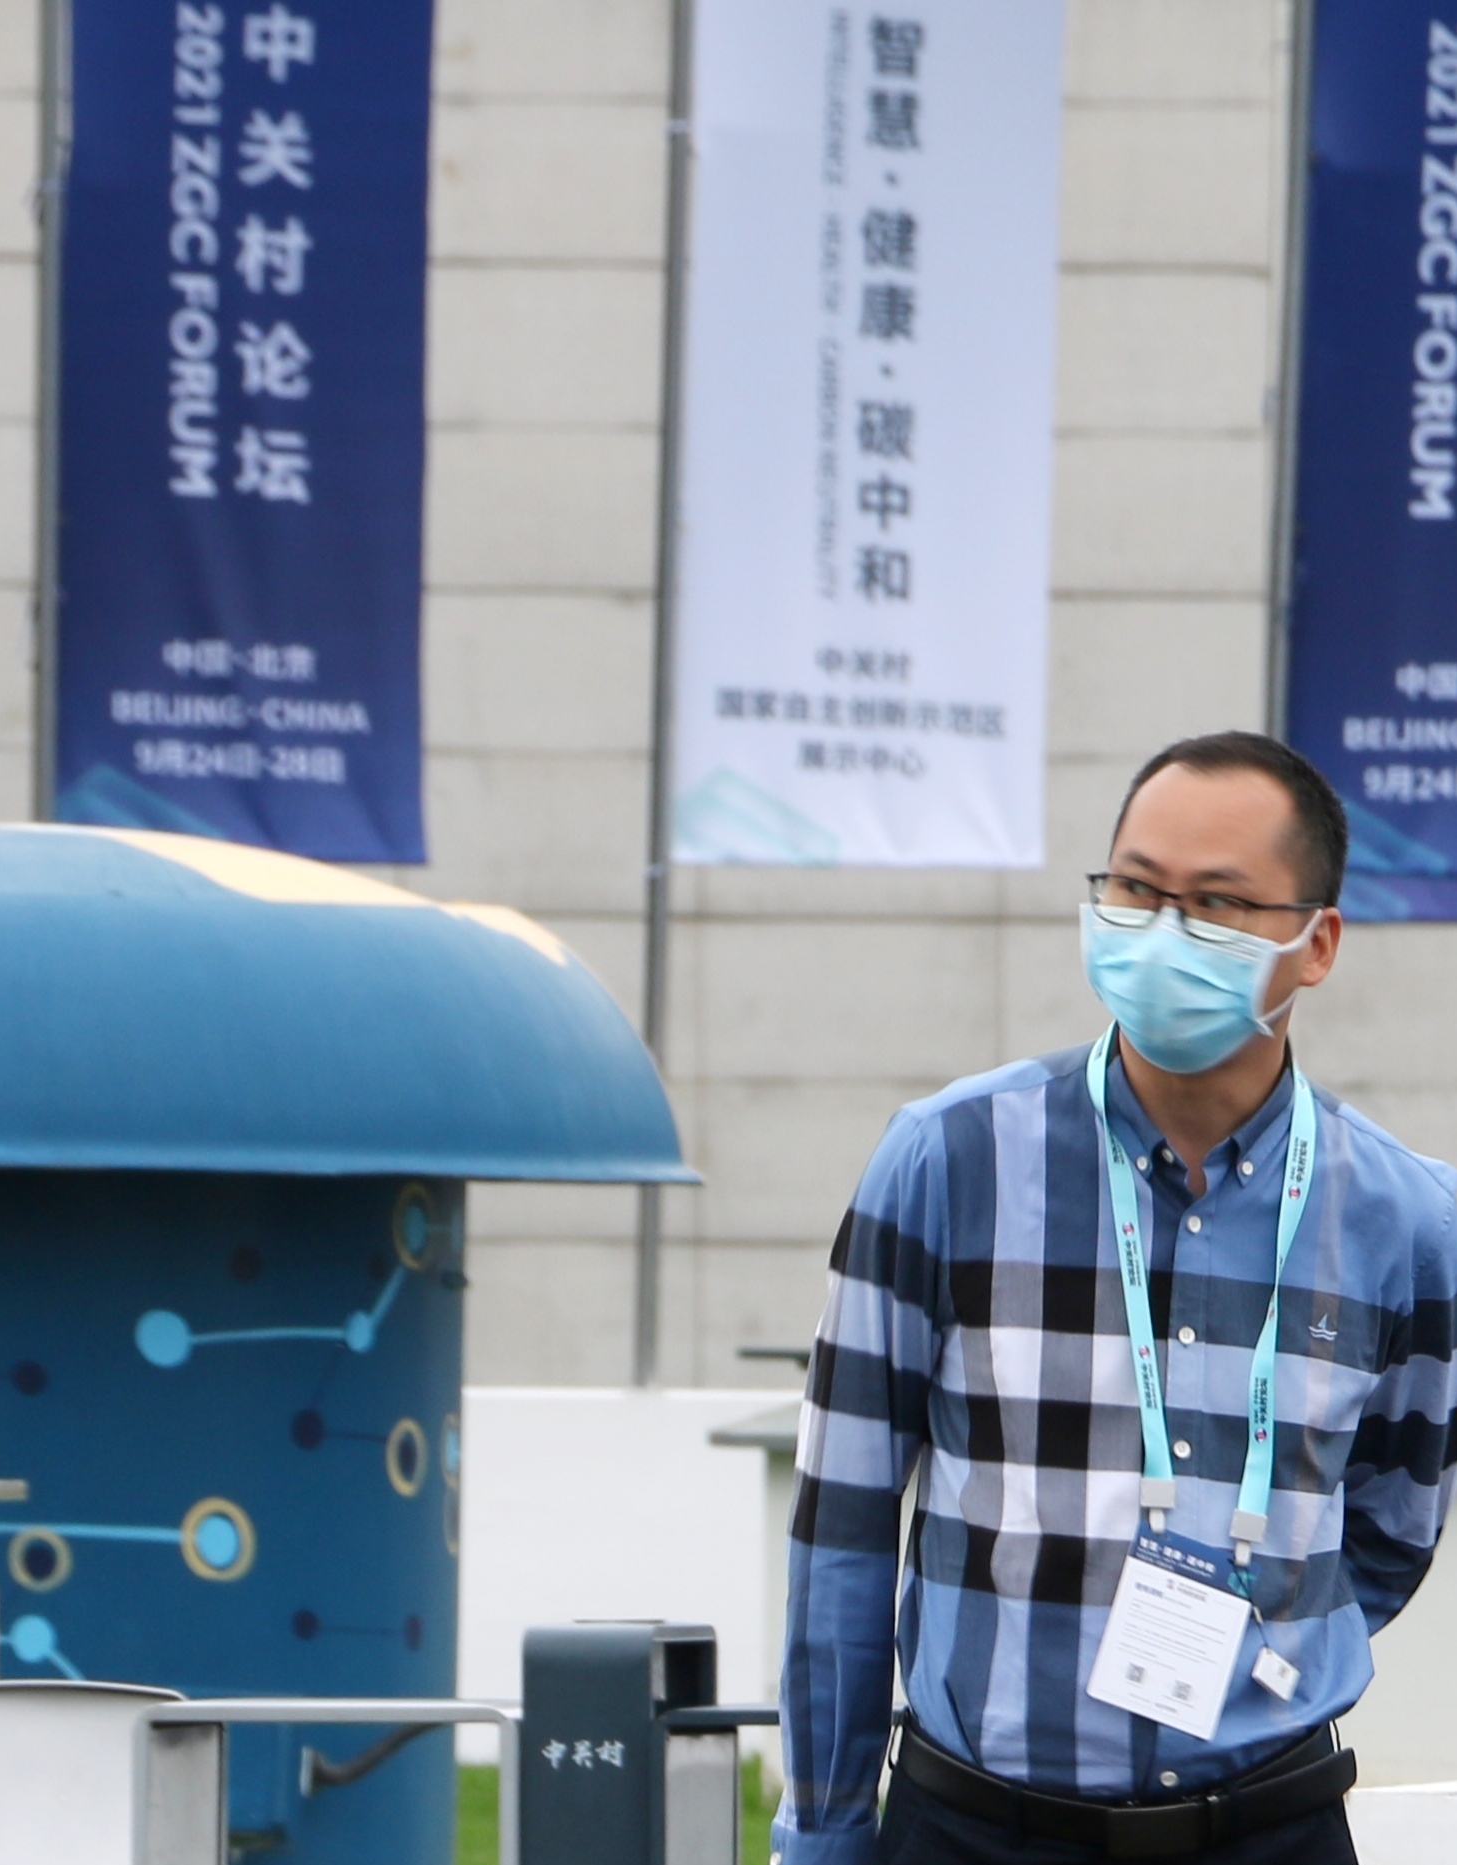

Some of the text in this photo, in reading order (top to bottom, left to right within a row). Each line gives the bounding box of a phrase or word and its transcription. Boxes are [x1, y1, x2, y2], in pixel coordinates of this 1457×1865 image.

[169, 2, 225, 500] 2021 ZGC FORUM
[236, 2, 316, 506] 中关村论坛
[855, 14, 926, 604] 智慧·健康·碳中和
[161, 638, 317, 683] 中国·北京
[815, 646, 914, 684] 中关村
[110, 690, 373, 735] BEIJING·CHINA
[715, 686, 1006, 740] 国家自主创新示范区
[133, 738, 347, 786] 9月24日-28日
[796, 739, 925, 780] 展示中心
